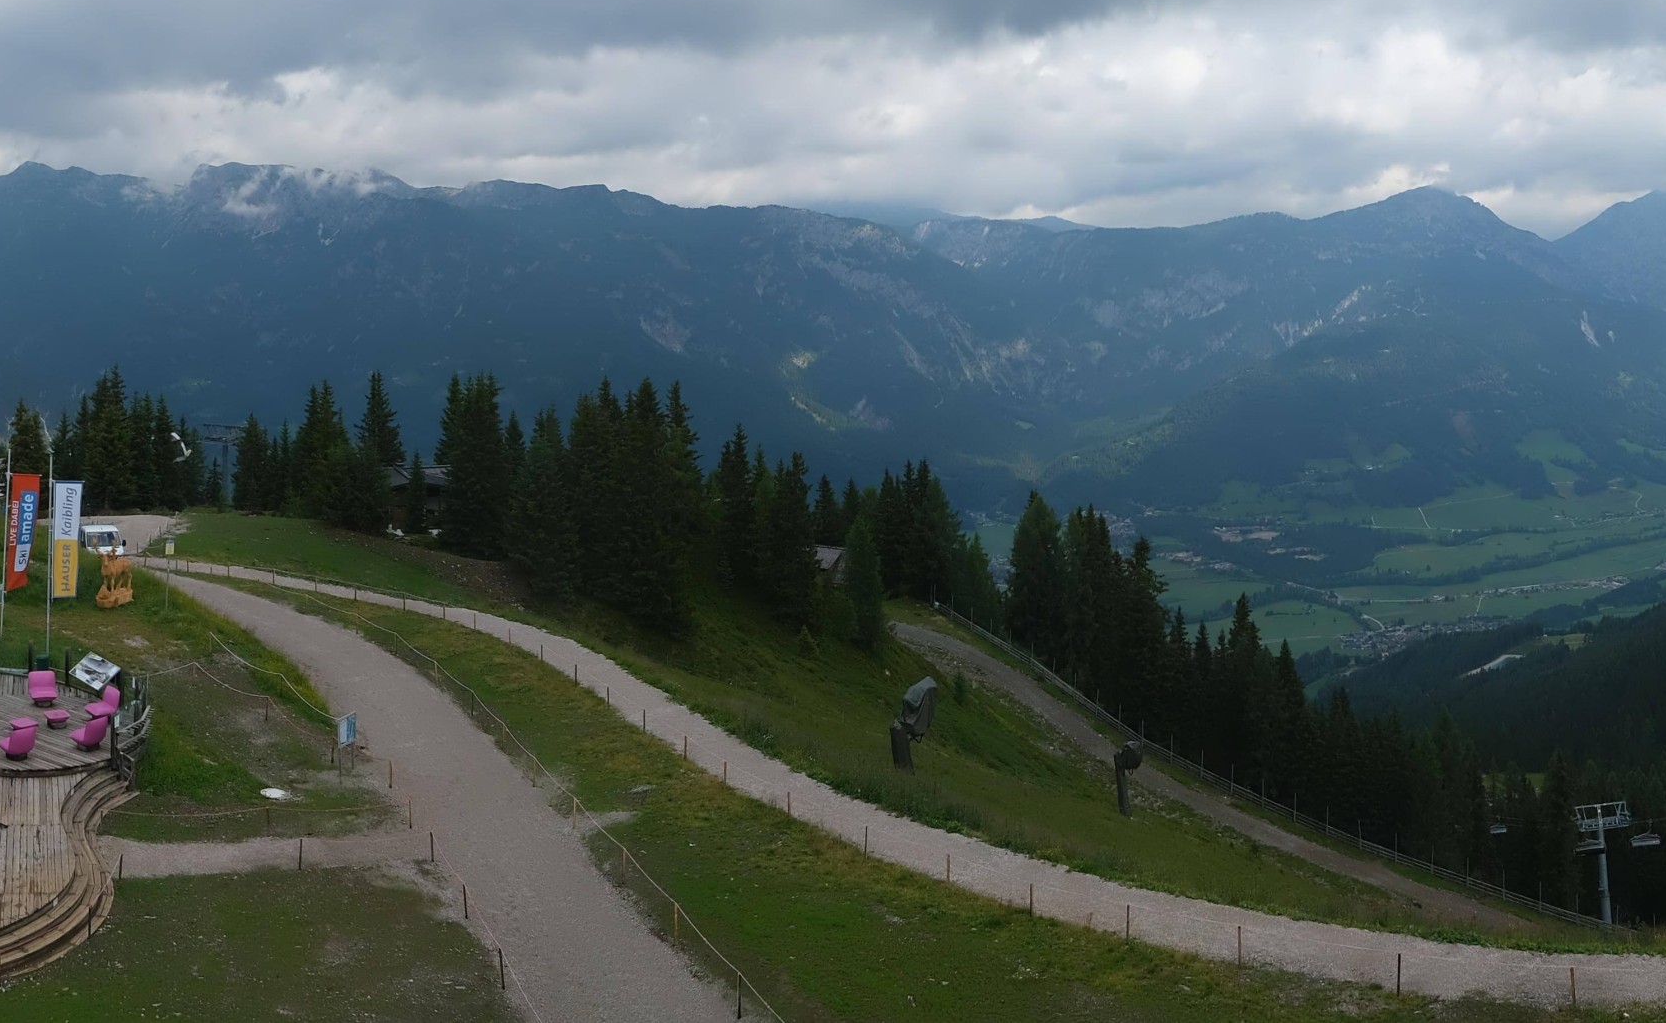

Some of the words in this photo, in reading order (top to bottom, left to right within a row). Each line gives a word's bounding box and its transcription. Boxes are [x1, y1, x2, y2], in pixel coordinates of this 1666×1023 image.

[11, 500, 20, 526] DABEI
[61, 487, 77, 537] Kaibling
[9, 526, 18, 546] LIVE
[18, 549, 27, 565] Ski
[61, 544, 71, 592] HAUSER
